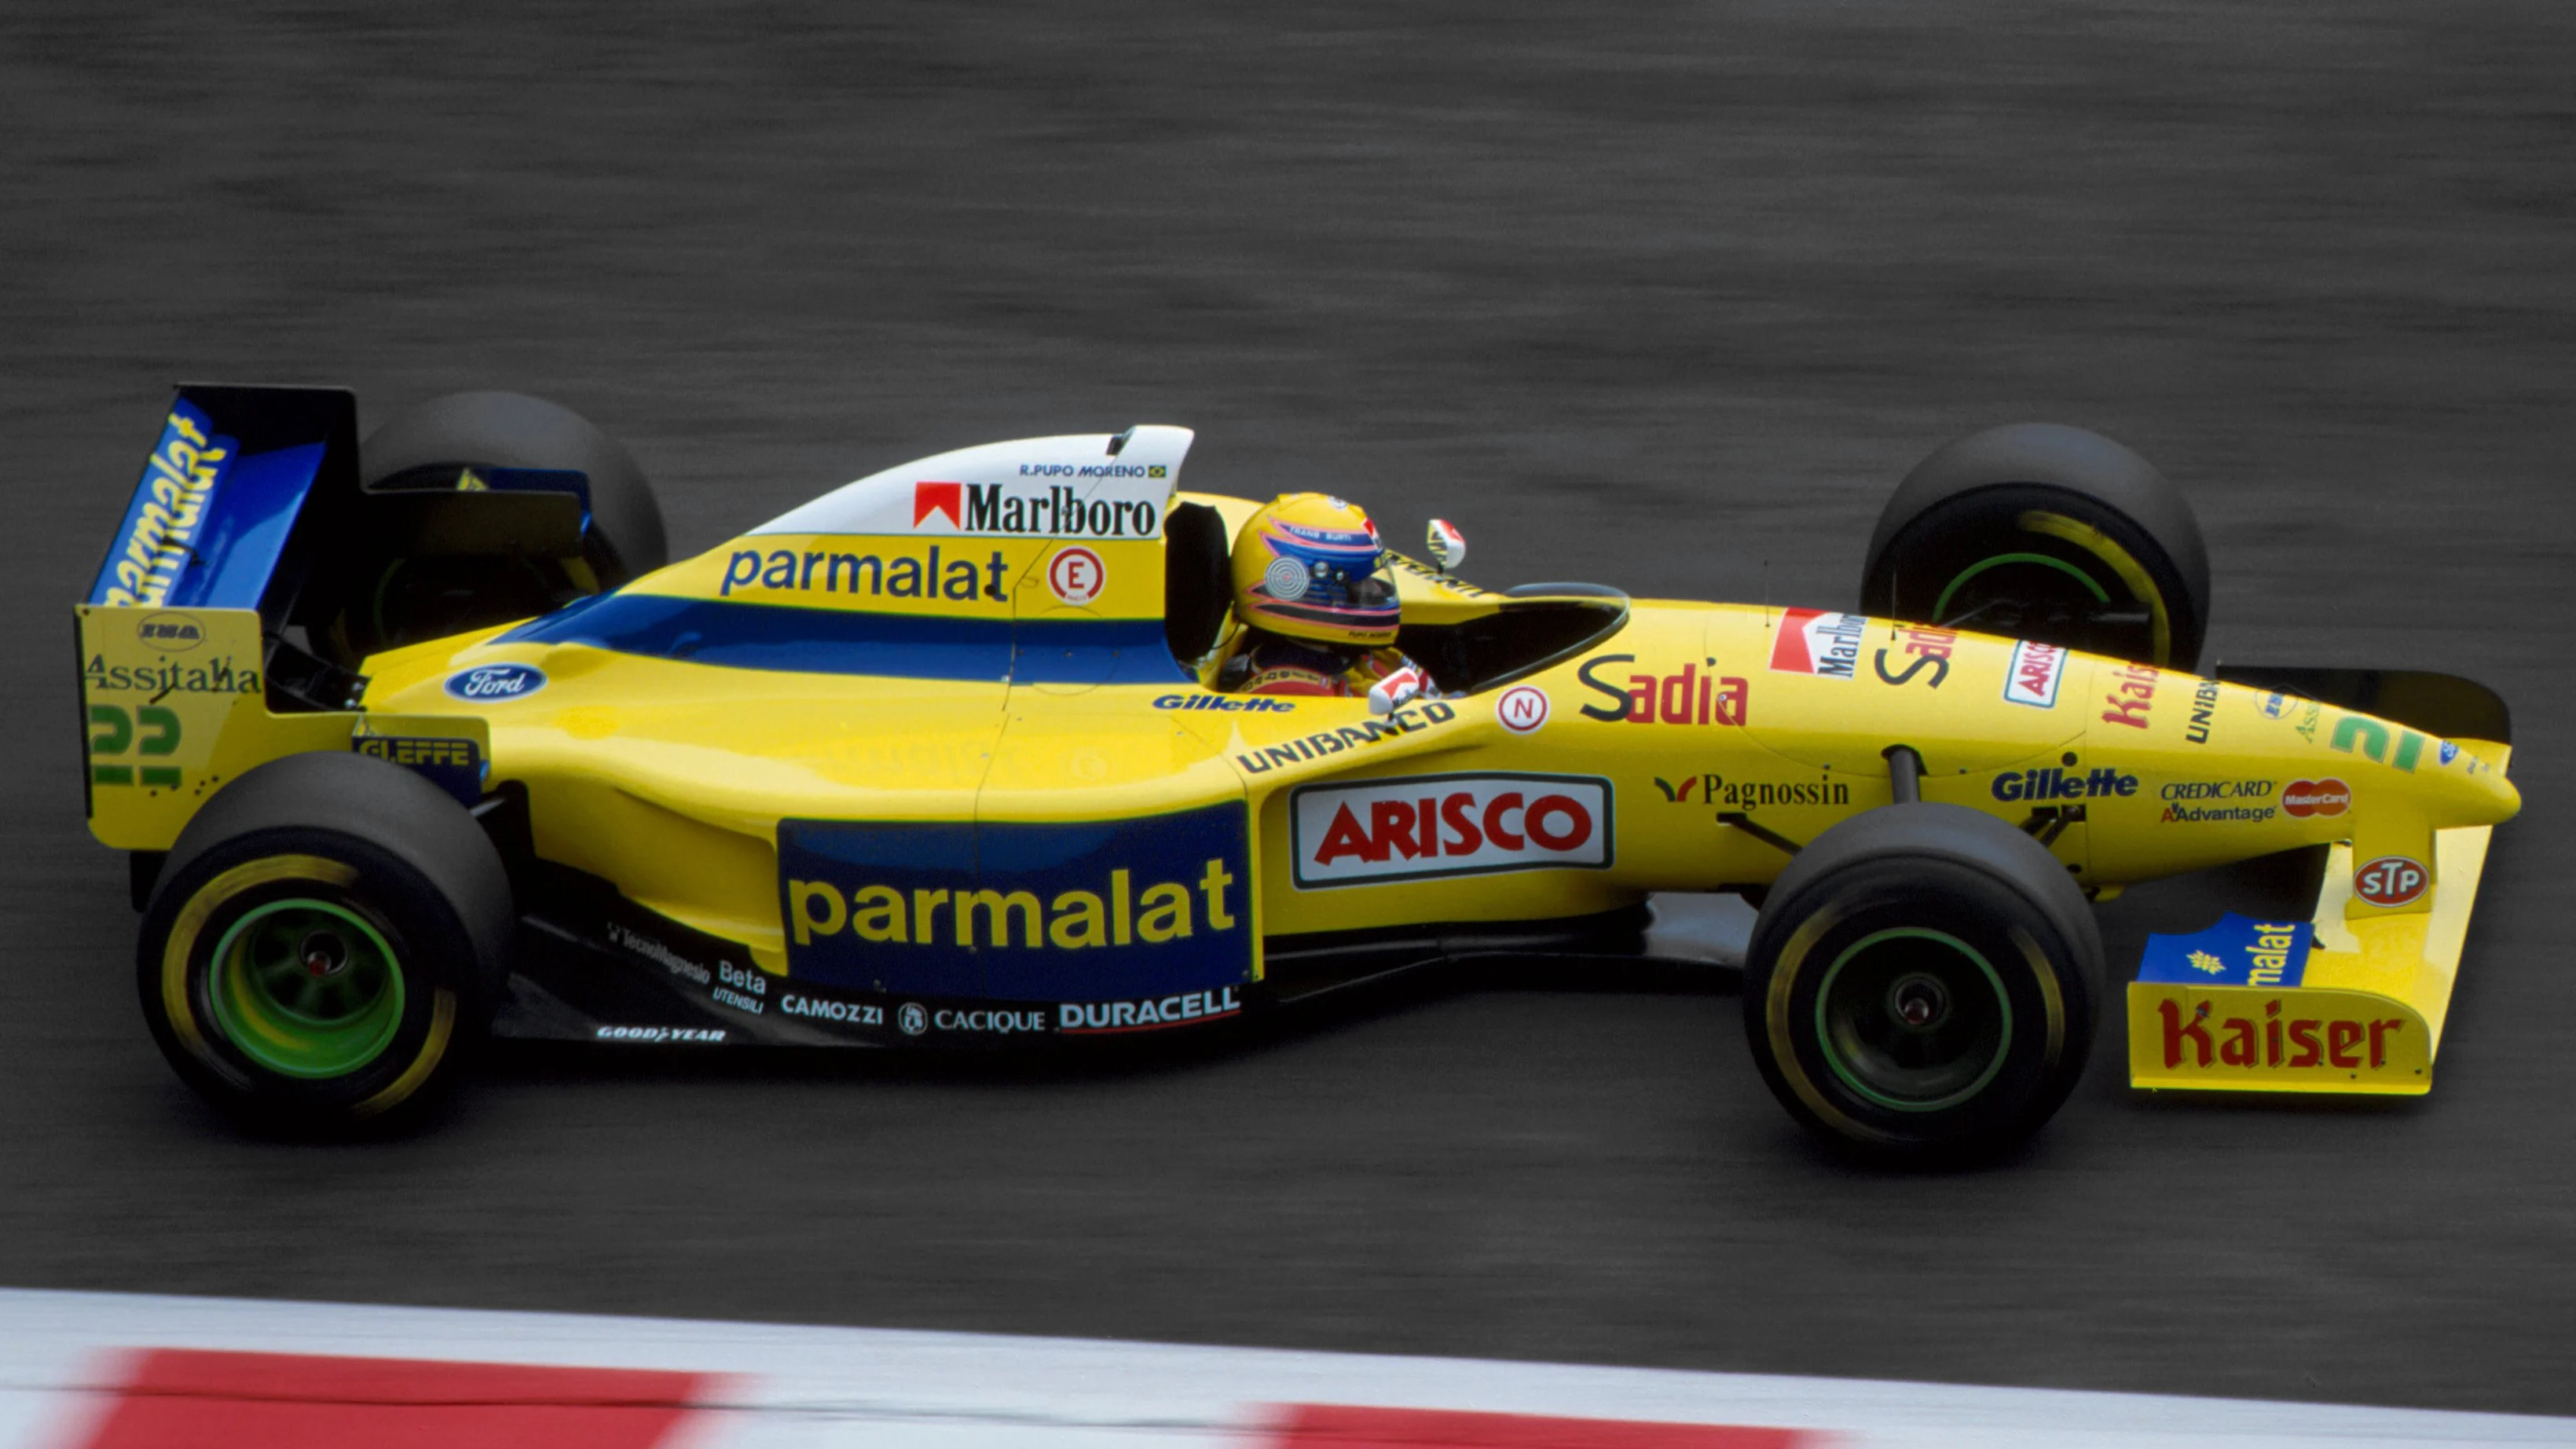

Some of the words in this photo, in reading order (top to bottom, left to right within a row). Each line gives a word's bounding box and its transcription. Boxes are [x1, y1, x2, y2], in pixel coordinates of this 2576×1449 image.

[1077, 465, 1145, 478] MORENO
[965, 483, 1156, 536] Marlboro
[720, 545, 1009, 602] parmalat
[1068, 562, 1084, 589] E
[85, 654, 262, 694] Assitalia
[464, 668, 526, 696] Ford
[1577, 654, 1749, 726] Sadia
[1152, 694, 1295, 713] Gillette
[1513, 697, 1534, 719] N
[89, 704, 182, 787] 22
[1236, 701, 1457, 775] UNIBANCO
[1702, 772, 1849, 812] Pagnossin
[1992, 768, 2138, 802] Gillette
[2160, 779, 2274, 802] CREDICARD
[2285, 793, 2349, 806] MasterCard
[1314, 792, 1592, 866] ARISCO
[2362, 862, 2420, 896] STP
[788, 858, 1235, 950] parmalat
[717, 959, 767, 996] Beta
[712, 986, 764, 1015] UTENSILI
[781, 995, 884, 1025] CAMOZZI
[1060, 986, 1240, 1029] DURACELL
[934, 1010, 1046, 1033] CACIQUE
[2157, 998, 2406, 1070] Kaiser
